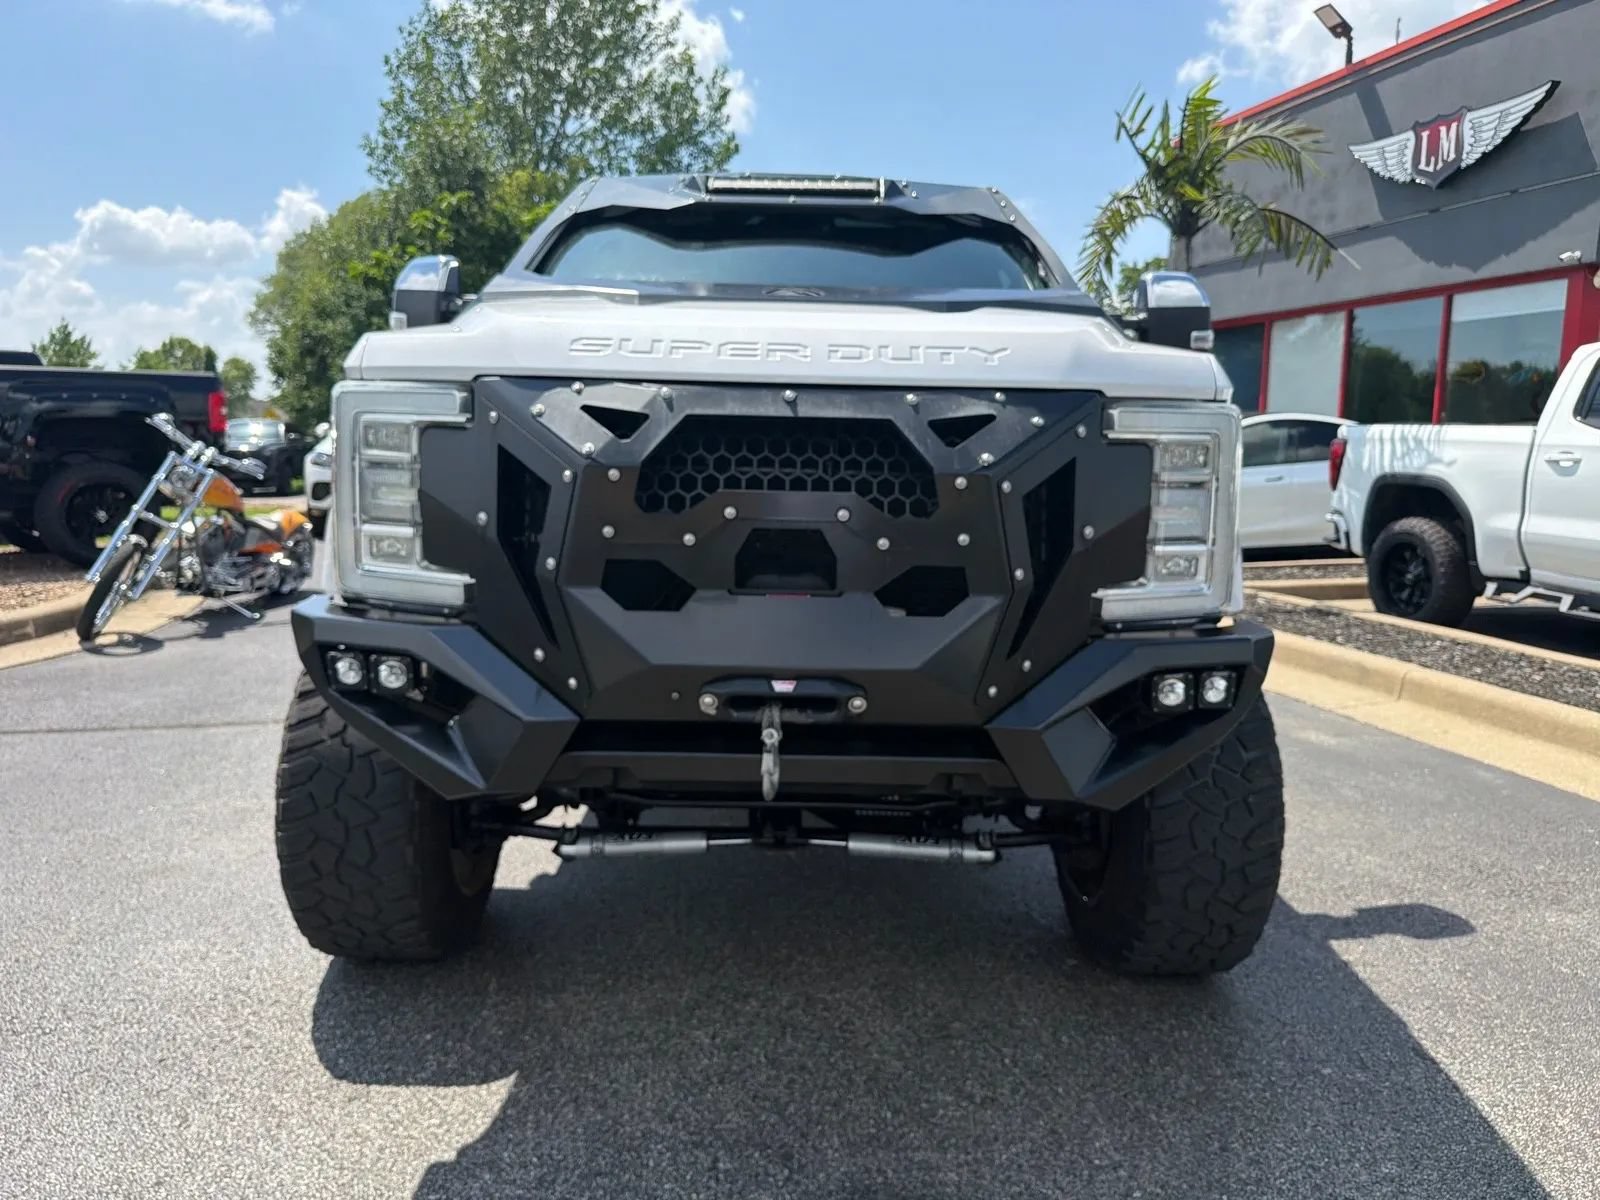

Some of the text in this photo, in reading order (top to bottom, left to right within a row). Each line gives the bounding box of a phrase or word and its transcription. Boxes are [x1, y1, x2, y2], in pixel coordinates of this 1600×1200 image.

[1418, 121, 1458, 173] LM
[568, 336, 1012, 367] SUPER DUTY
